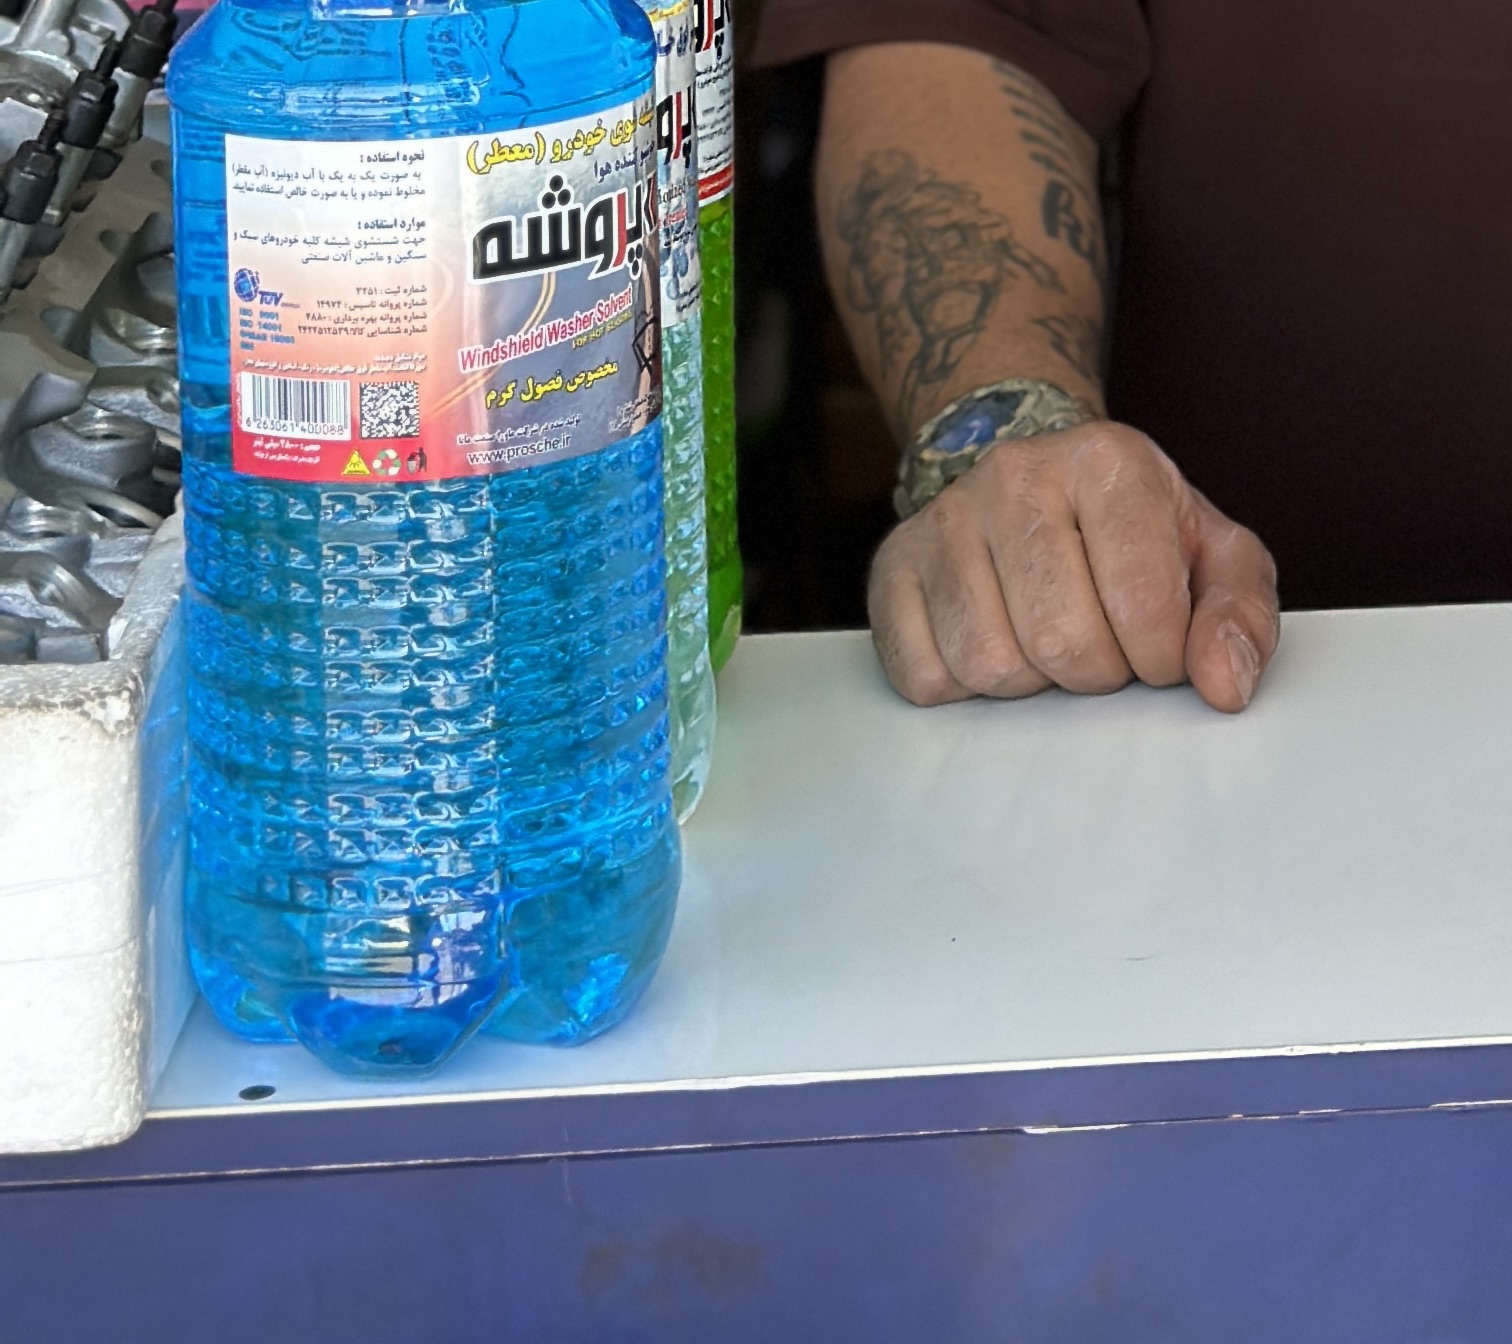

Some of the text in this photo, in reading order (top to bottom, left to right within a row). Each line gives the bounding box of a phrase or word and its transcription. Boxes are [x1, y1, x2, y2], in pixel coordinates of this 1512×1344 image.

[550, 118, 607, 163] خودرو
[402, 150, 425, 165] نحوه
[466, 131, 546, 175] (معطر)
[303, 168, 314, 182] آب
[329, 171, 343, 183] یک
[360, 171, 375, 183] یک
[380, 172, 408, 183] صورت
[311, 189, 337, 201] صورت
[368, 188, 392, 200] نموده
[396, 186, 426, 199] مخلوط
[400, 217, 426, 232] موارد
[472, 174, 643, 280] پروشه
[261, 232, 298, 248] خودروهای
[333, 249, 352, 262] آلات
[395, 250, 427, 264] سنگین
[403, 285, 427, 297] شماره
[403, 298, 427, 309] شماره
[403, 311, 427, 322] شماره
[403, 325, 427, 336] شماره
[460, 326, 544, 372] Windshield
[546, 311, 594, 345] Washer
[596, 286, 633, 323] Solvent
[566, 357, 619, 392] مخصوص
[520, 369, 563, 402] فصول
[467, 432, 571, 464] www.prosche.ir
